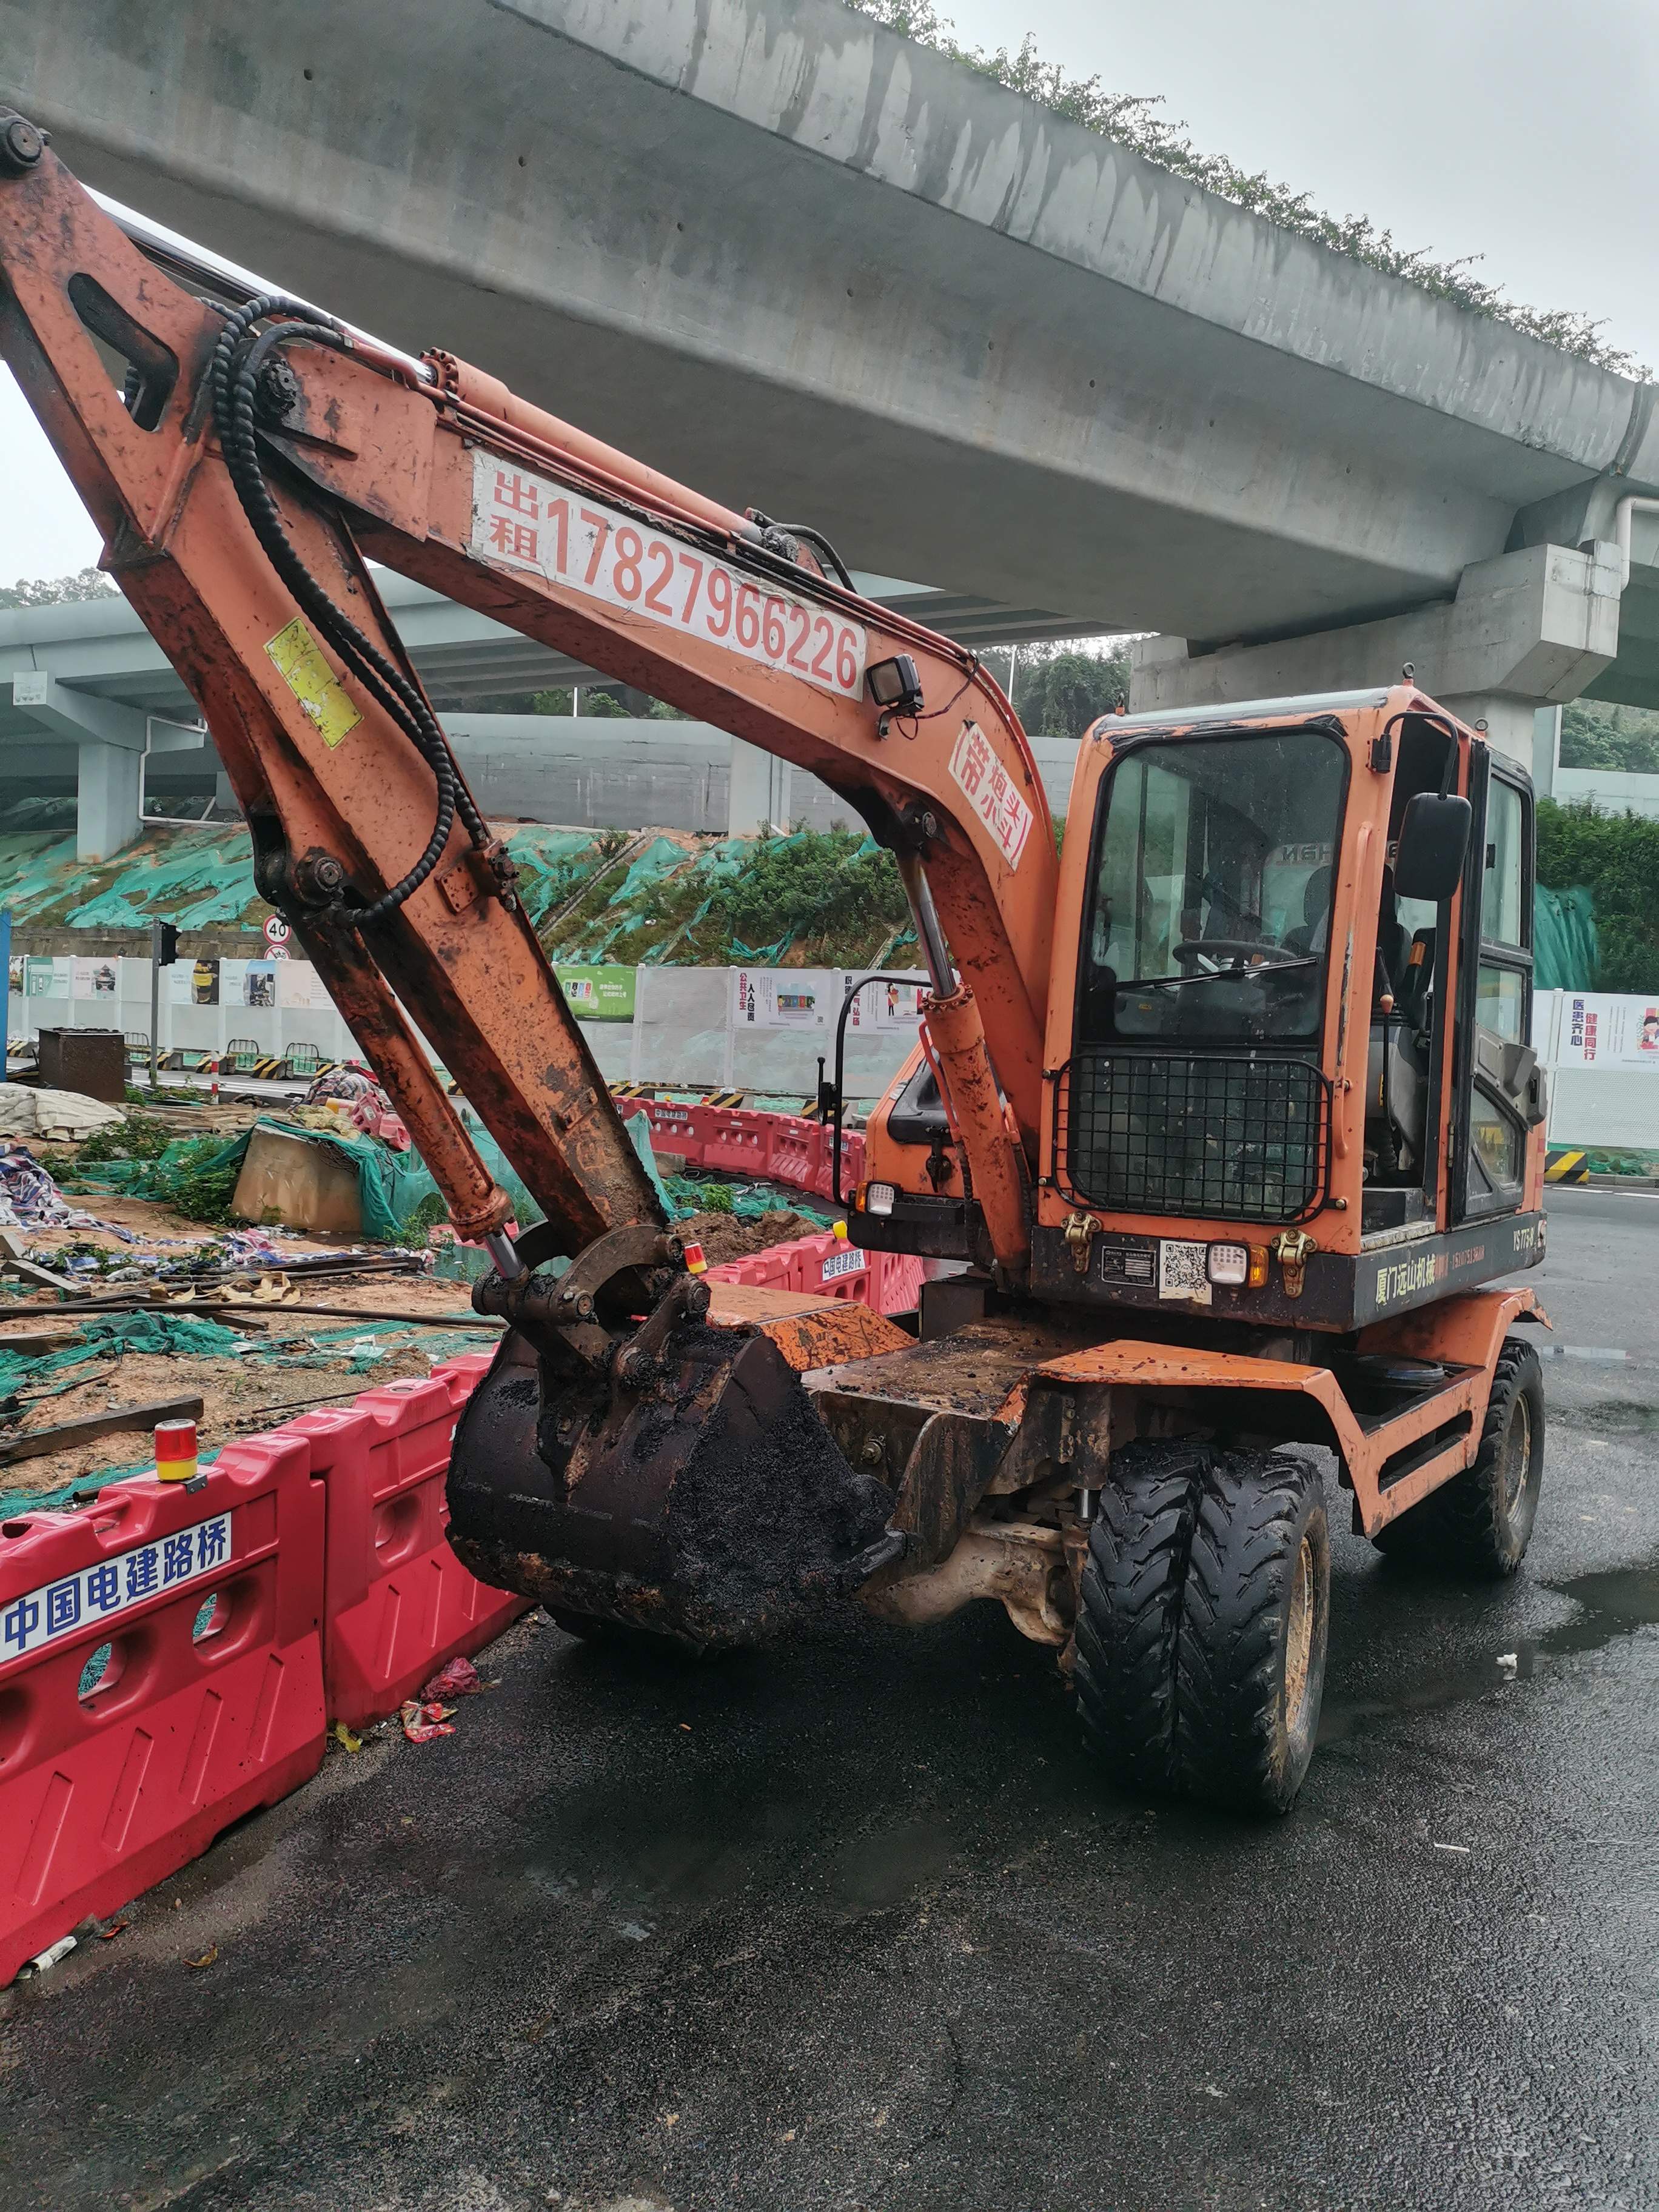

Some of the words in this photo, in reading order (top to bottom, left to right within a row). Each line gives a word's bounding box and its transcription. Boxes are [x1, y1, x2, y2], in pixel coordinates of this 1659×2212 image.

[548, 497, 857, 689] 17827966226
[269, 923, 286, 937] 40
[1570, 999, 1584, 1046] 医患齐心
[1584, 1013, 1598, 1061] 健康同行
[1376, 1253, 1437, 1306] 厦门远山机械
[5, 1518, 227, 1651] 中国电建路桥
